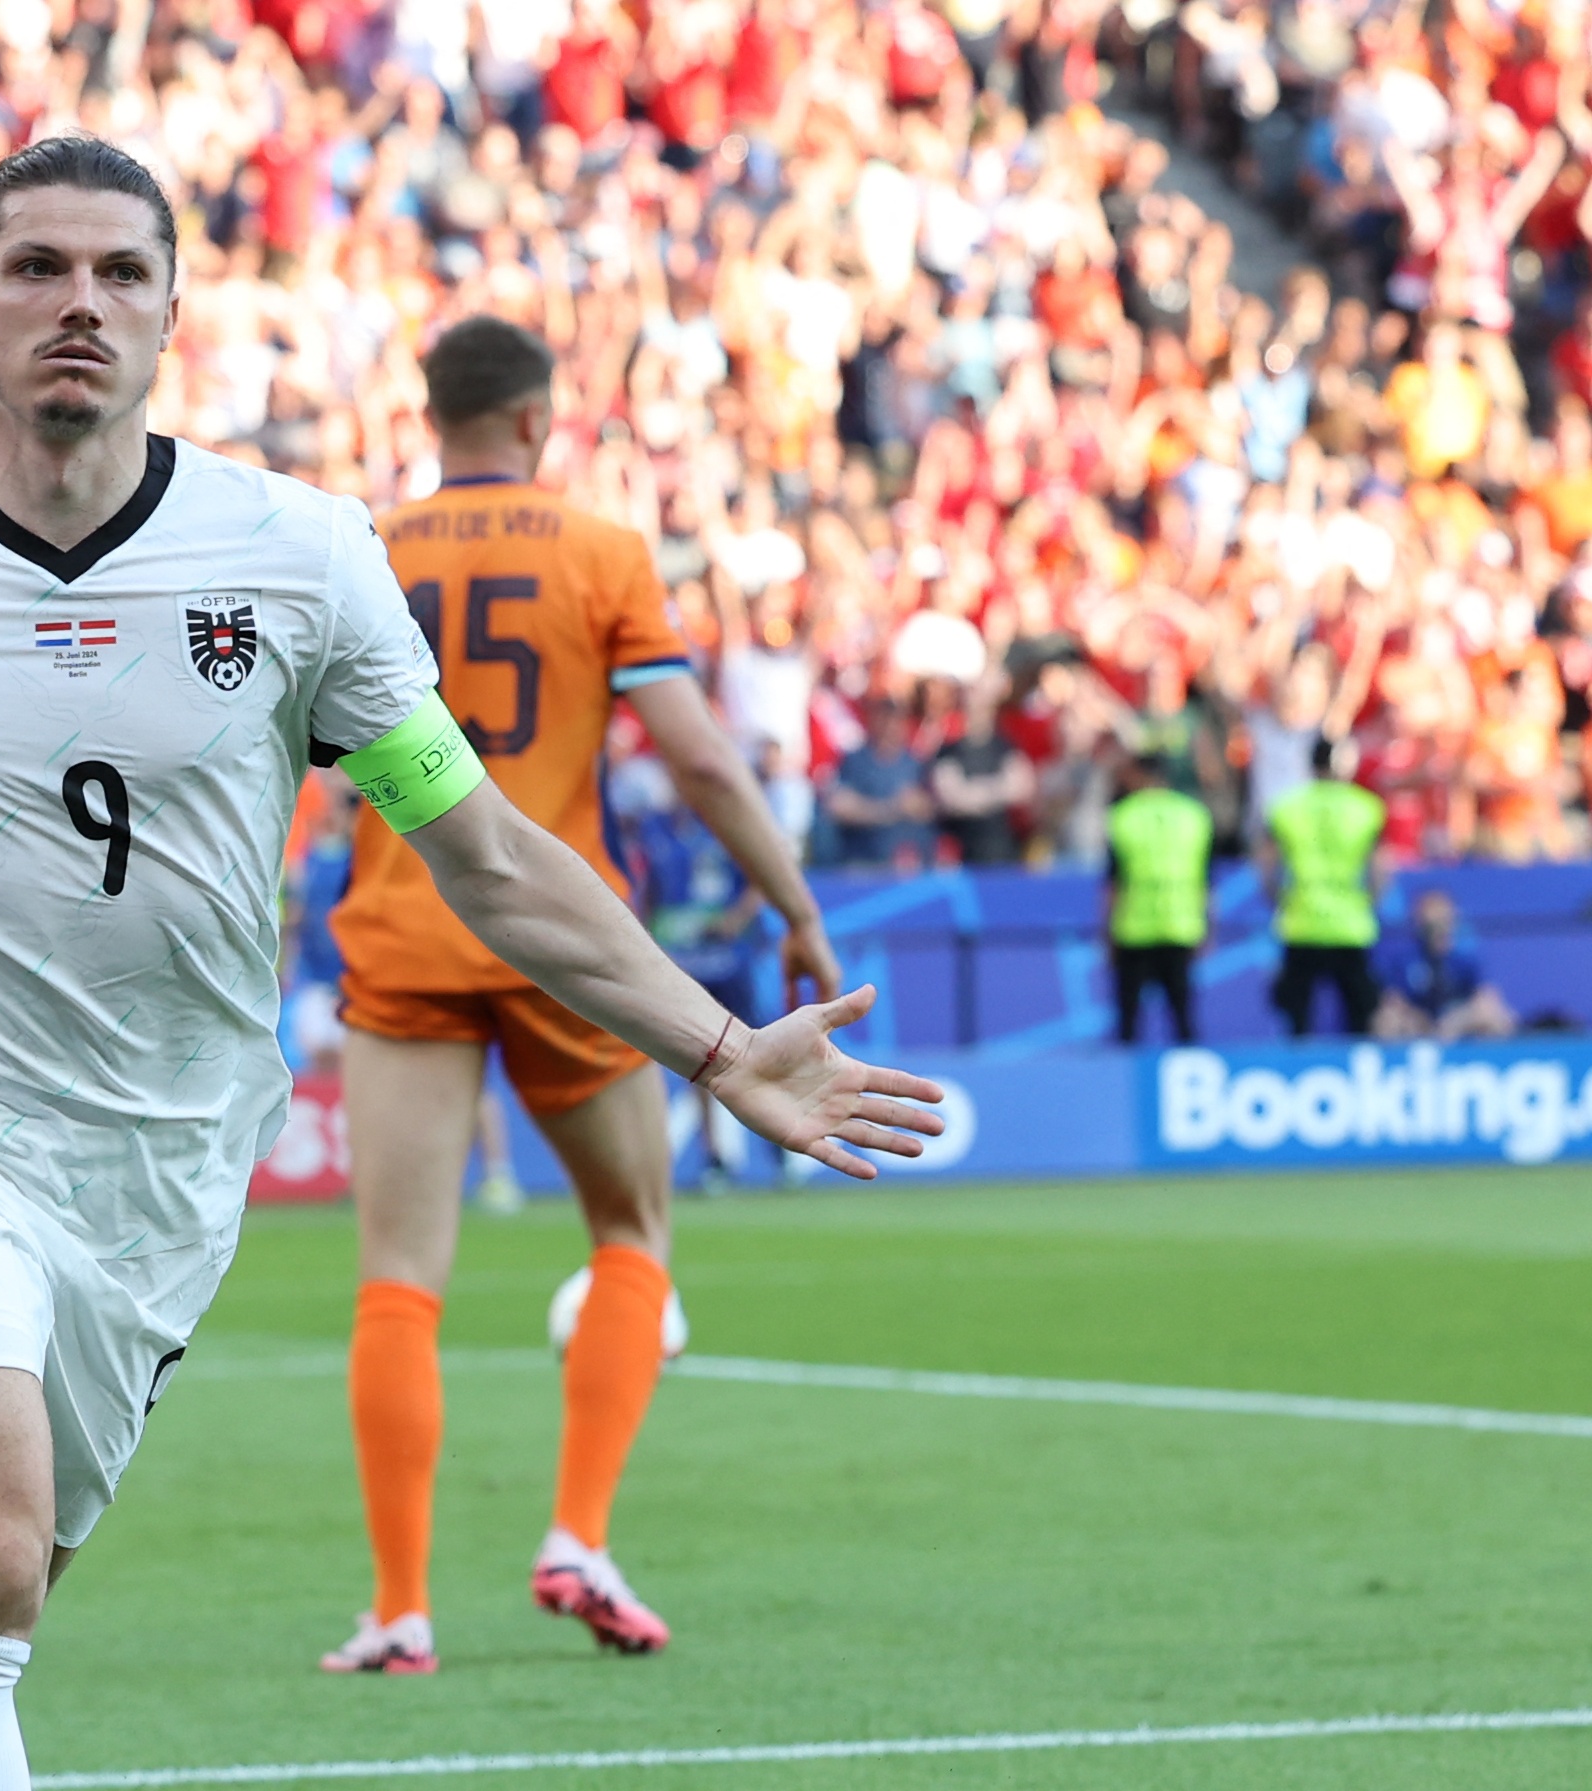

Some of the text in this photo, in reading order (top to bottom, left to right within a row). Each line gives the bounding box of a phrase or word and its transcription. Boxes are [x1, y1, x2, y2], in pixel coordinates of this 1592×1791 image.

[201, 596, 236, 607] ÖFB
[82, 650, 98, 658] 2024
[53, 660, 101, 670] Olympiastadion
[62, 760, 131, 896] 9
[1158, 1042, 1592, 1164] Booking.
